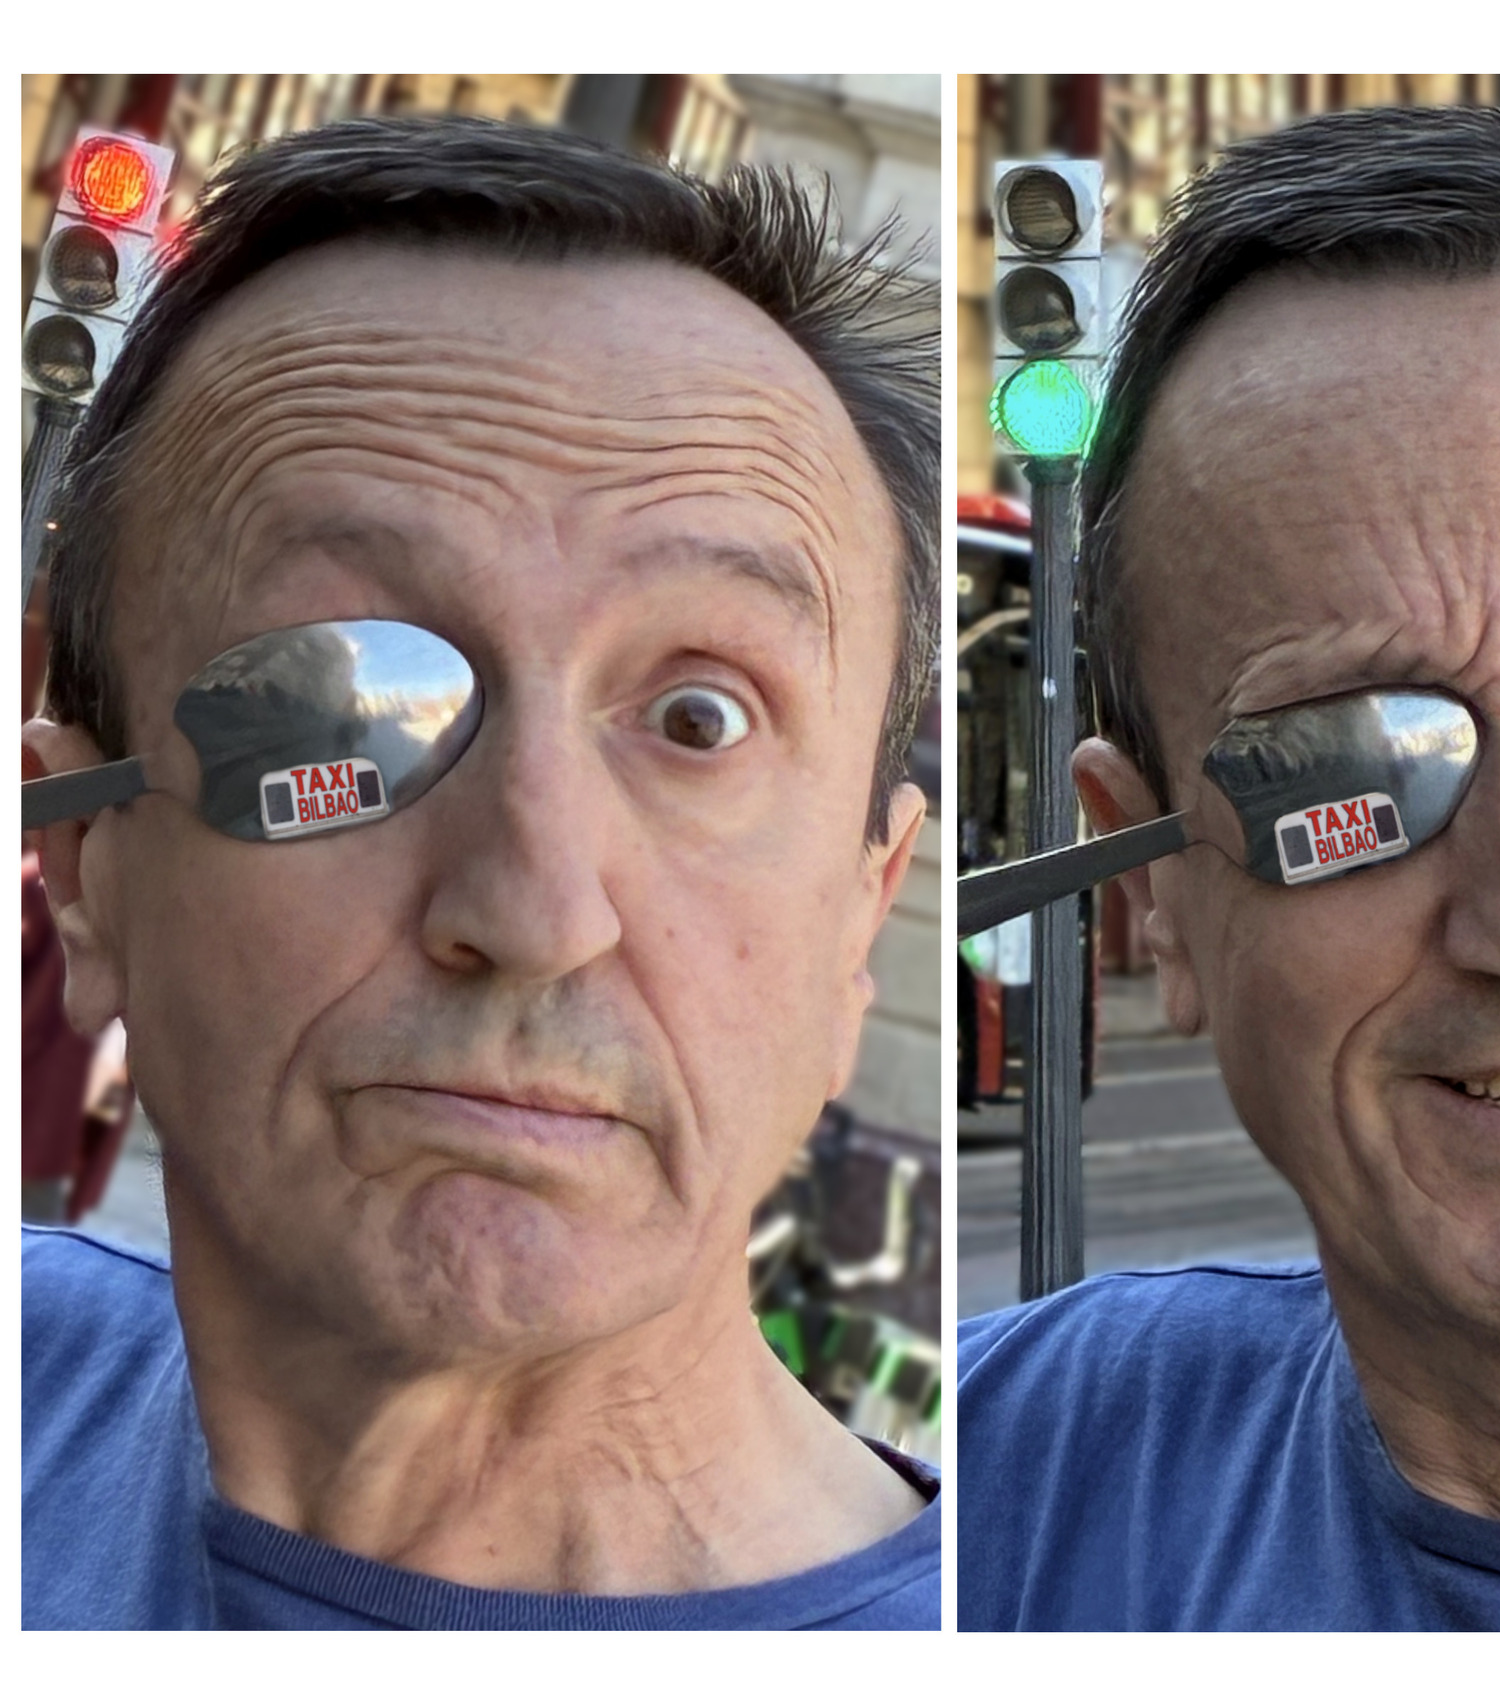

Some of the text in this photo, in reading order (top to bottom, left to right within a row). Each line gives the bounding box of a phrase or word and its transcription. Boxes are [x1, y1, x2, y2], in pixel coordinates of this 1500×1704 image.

[290, 763, 355, 795] TAXI
[297, 790, 359, 823] BILBAO
[1305, 799, 1372, 836] TAXI
[1315, 826, 1377, 864] BILBAO
